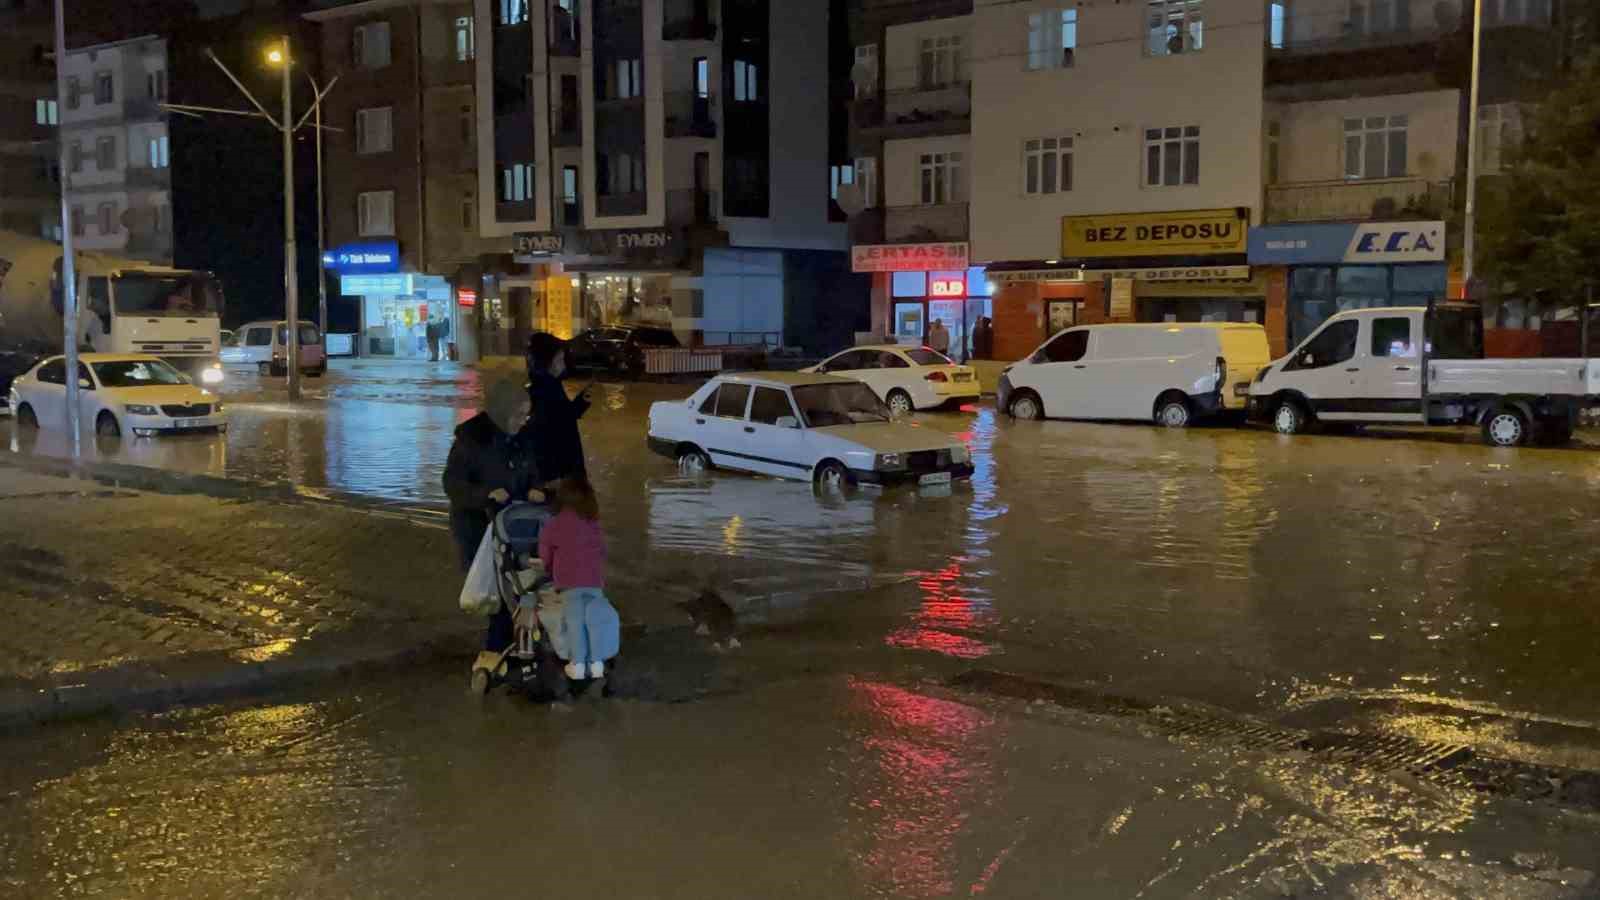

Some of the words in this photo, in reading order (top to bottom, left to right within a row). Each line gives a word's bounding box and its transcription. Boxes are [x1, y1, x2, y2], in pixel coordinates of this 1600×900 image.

[616, 232, 667, 248] EYMEN
[1085, 226, 1128, 243] BEZ
[1136, 222, 1232, 241] DEPOSU
[519, 236, 563, 251] EYMEN
